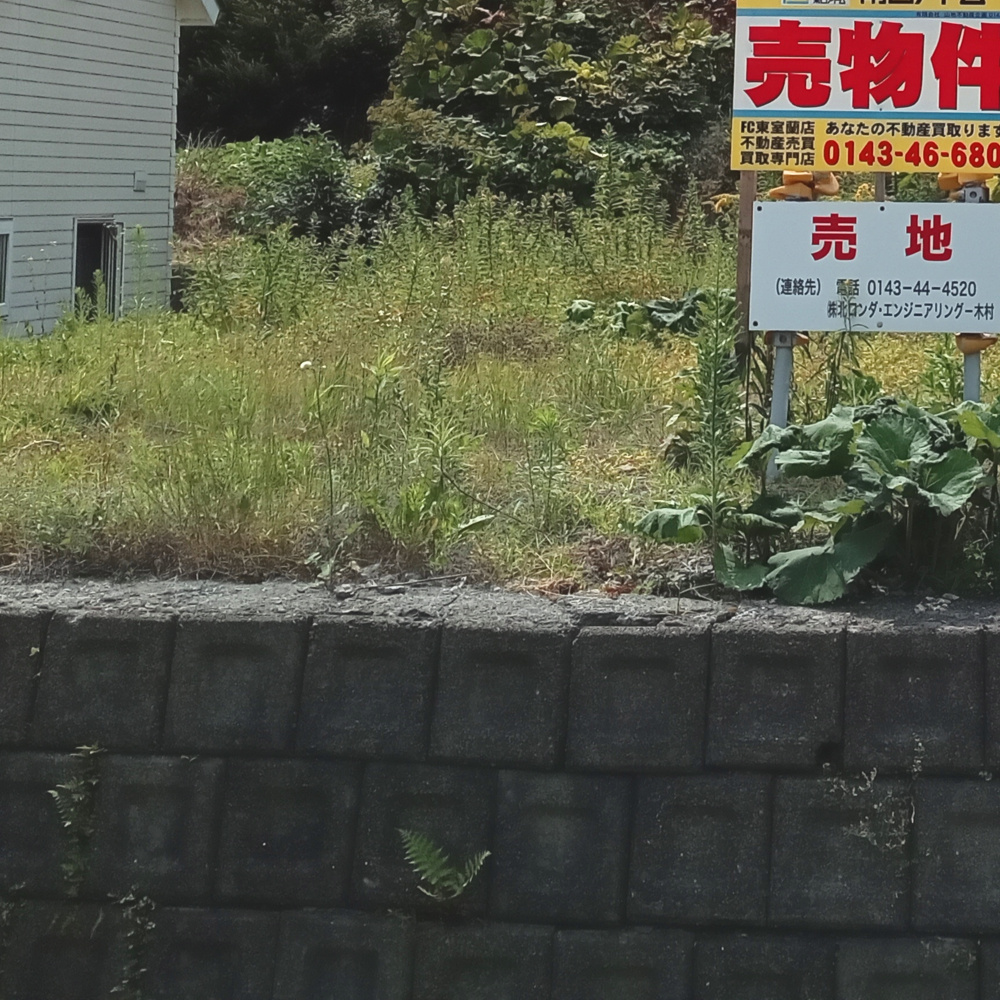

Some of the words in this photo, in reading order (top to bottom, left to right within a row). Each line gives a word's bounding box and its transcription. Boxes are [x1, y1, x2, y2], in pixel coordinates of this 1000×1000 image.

[740, 120, 815, 135] FC東室蘭店
[740, 136, 816, 150] 不動産売買
[740, 151, 815, 166] 買取専門店
